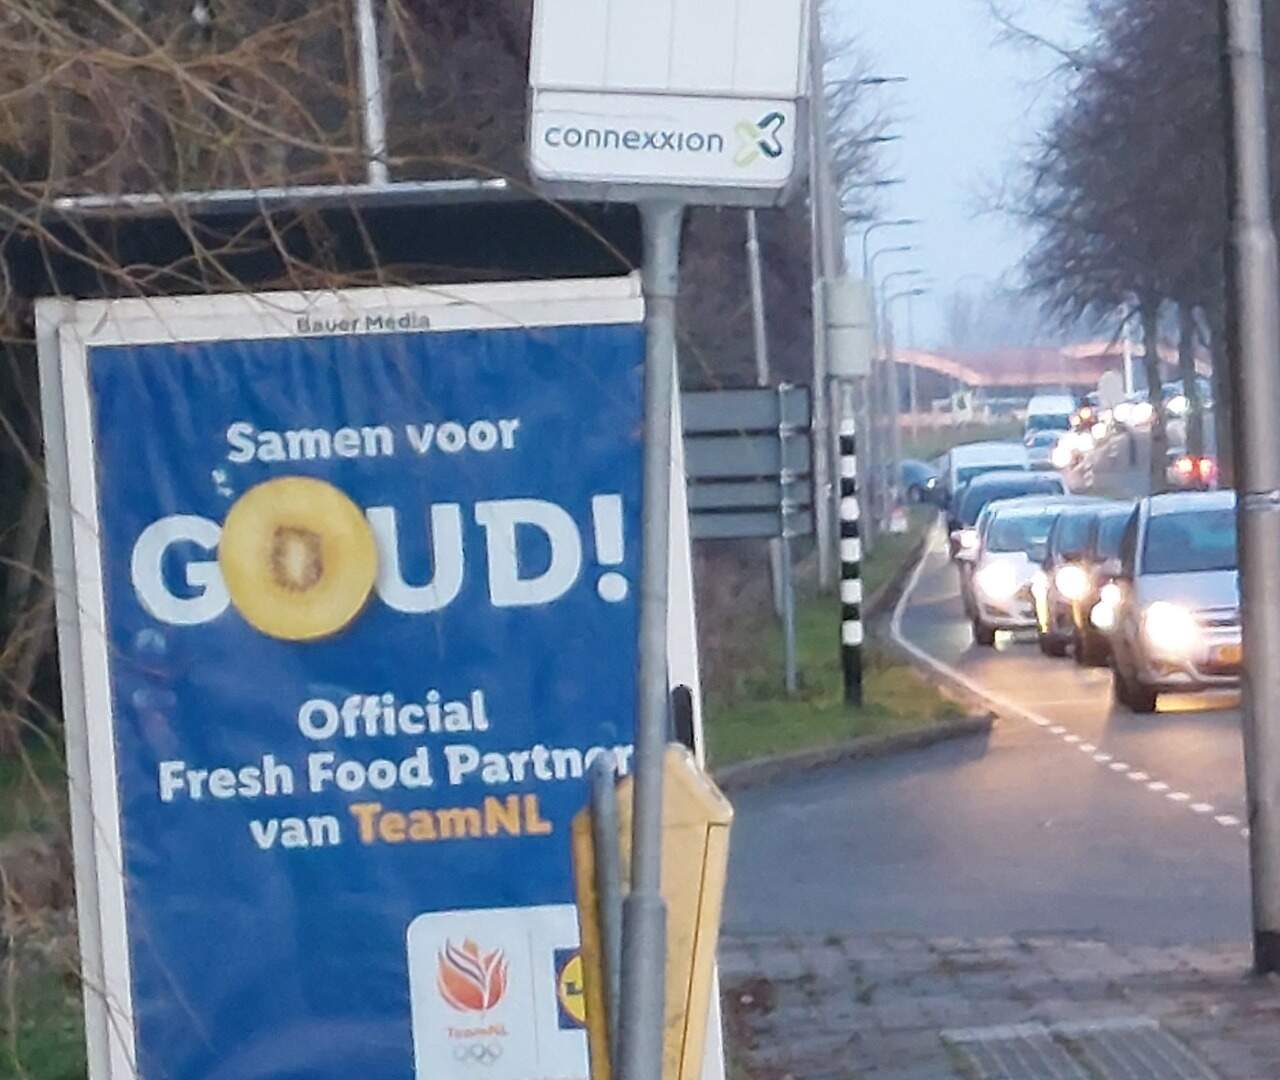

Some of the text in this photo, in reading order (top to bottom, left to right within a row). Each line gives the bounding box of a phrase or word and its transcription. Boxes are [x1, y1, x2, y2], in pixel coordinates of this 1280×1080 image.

[544, 123, 724, 154] connexxion
[296, 311, 431, 333] Bauer Media
[226, 416, 520, 464] Samen voor
[130, 475, 629, 642] GOUD!
[299, 689, 489, 740] Official
[159, 754, 294, 802] Fresh
[308, 745, 434, 793] Food
[250, 794, 553, 850] van TeamNL
